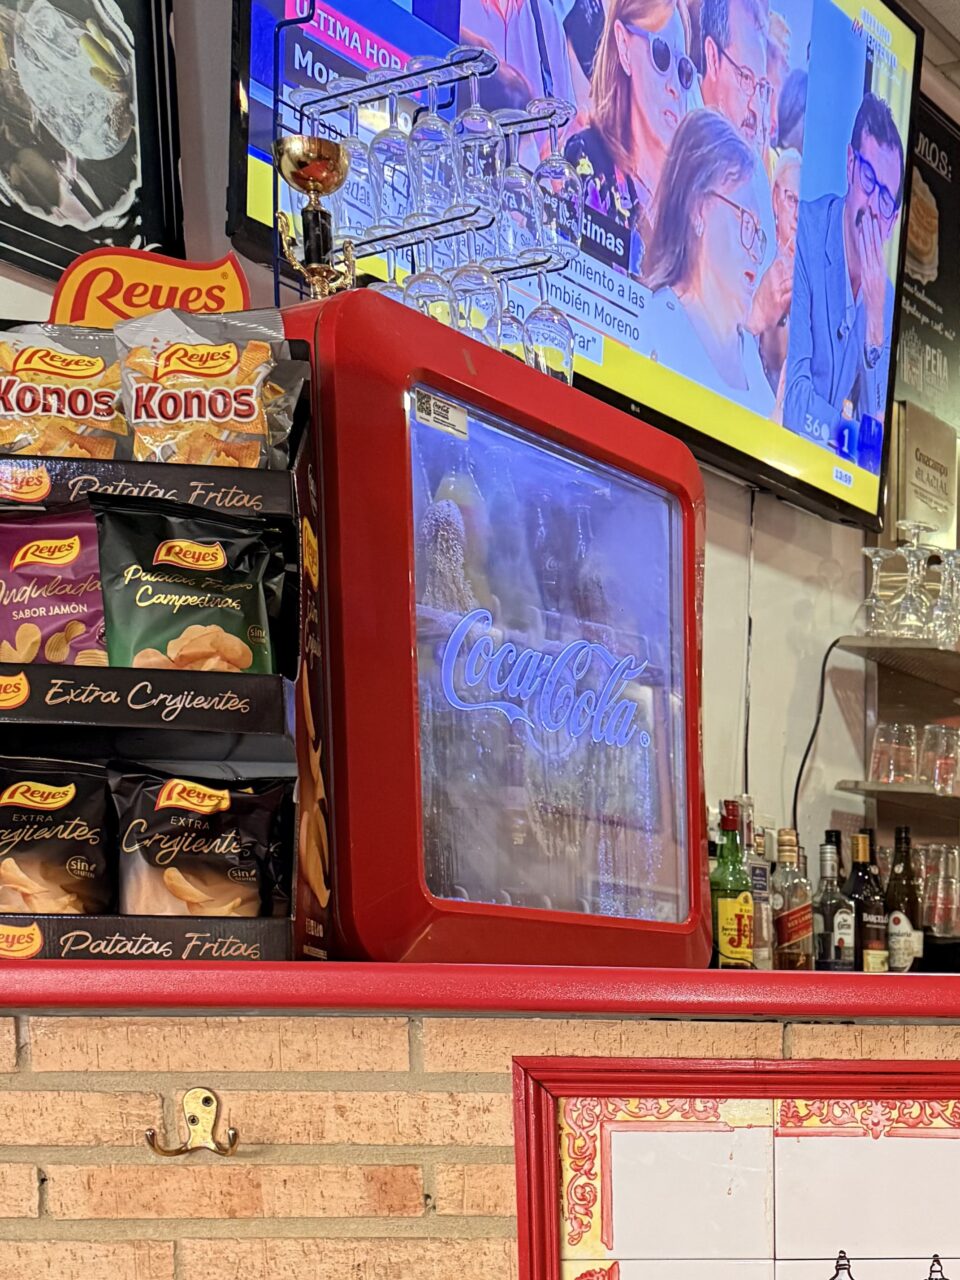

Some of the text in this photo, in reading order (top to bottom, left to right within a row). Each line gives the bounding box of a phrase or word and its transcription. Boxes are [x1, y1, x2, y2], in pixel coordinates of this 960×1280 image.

[365, 39, 408, 73] HOR
[581, 211, 627, 256] timas
[70, 266, 226, 324] Reyes
[569, 256, 646, 310] miento a las
[549, 279, 640, 341] mbién Moreno
[24, 350, 97, 368] Reyes
[165, 348, 231, 365] Reyes
[925, 343, 948, 382] PEÑA
[134, 383, 257, 421] Konos
[914, 447, 949, 478] Cruzcampo
[187, 481, 264, 512] Fritas
[22, 541, 76, 562] Reyes
[165, 544, 219, 563] Reyes
[12, 601, 88, 621] SABOR JAMÓN
[135, 586, 242, 614] Campesinas
[441, 608, 649, 748] Coca-Cola
[45, 679, 250, 721] Extra Crujientes
[7, 784, 69, 802] Reyes
[166, 782, 227, 804] Reyes
[12, 814, 54, 823] EXTRA
[170, 815, 210, 830] EXTRA
[122, 818, 251, 865] Crujientes
[70, 858, 90, 871] sin
[231, 867, 249, 878] sin
[0, 930, 35, 946] eyes
[60, 930, 261, 960] Patatas Fritas
